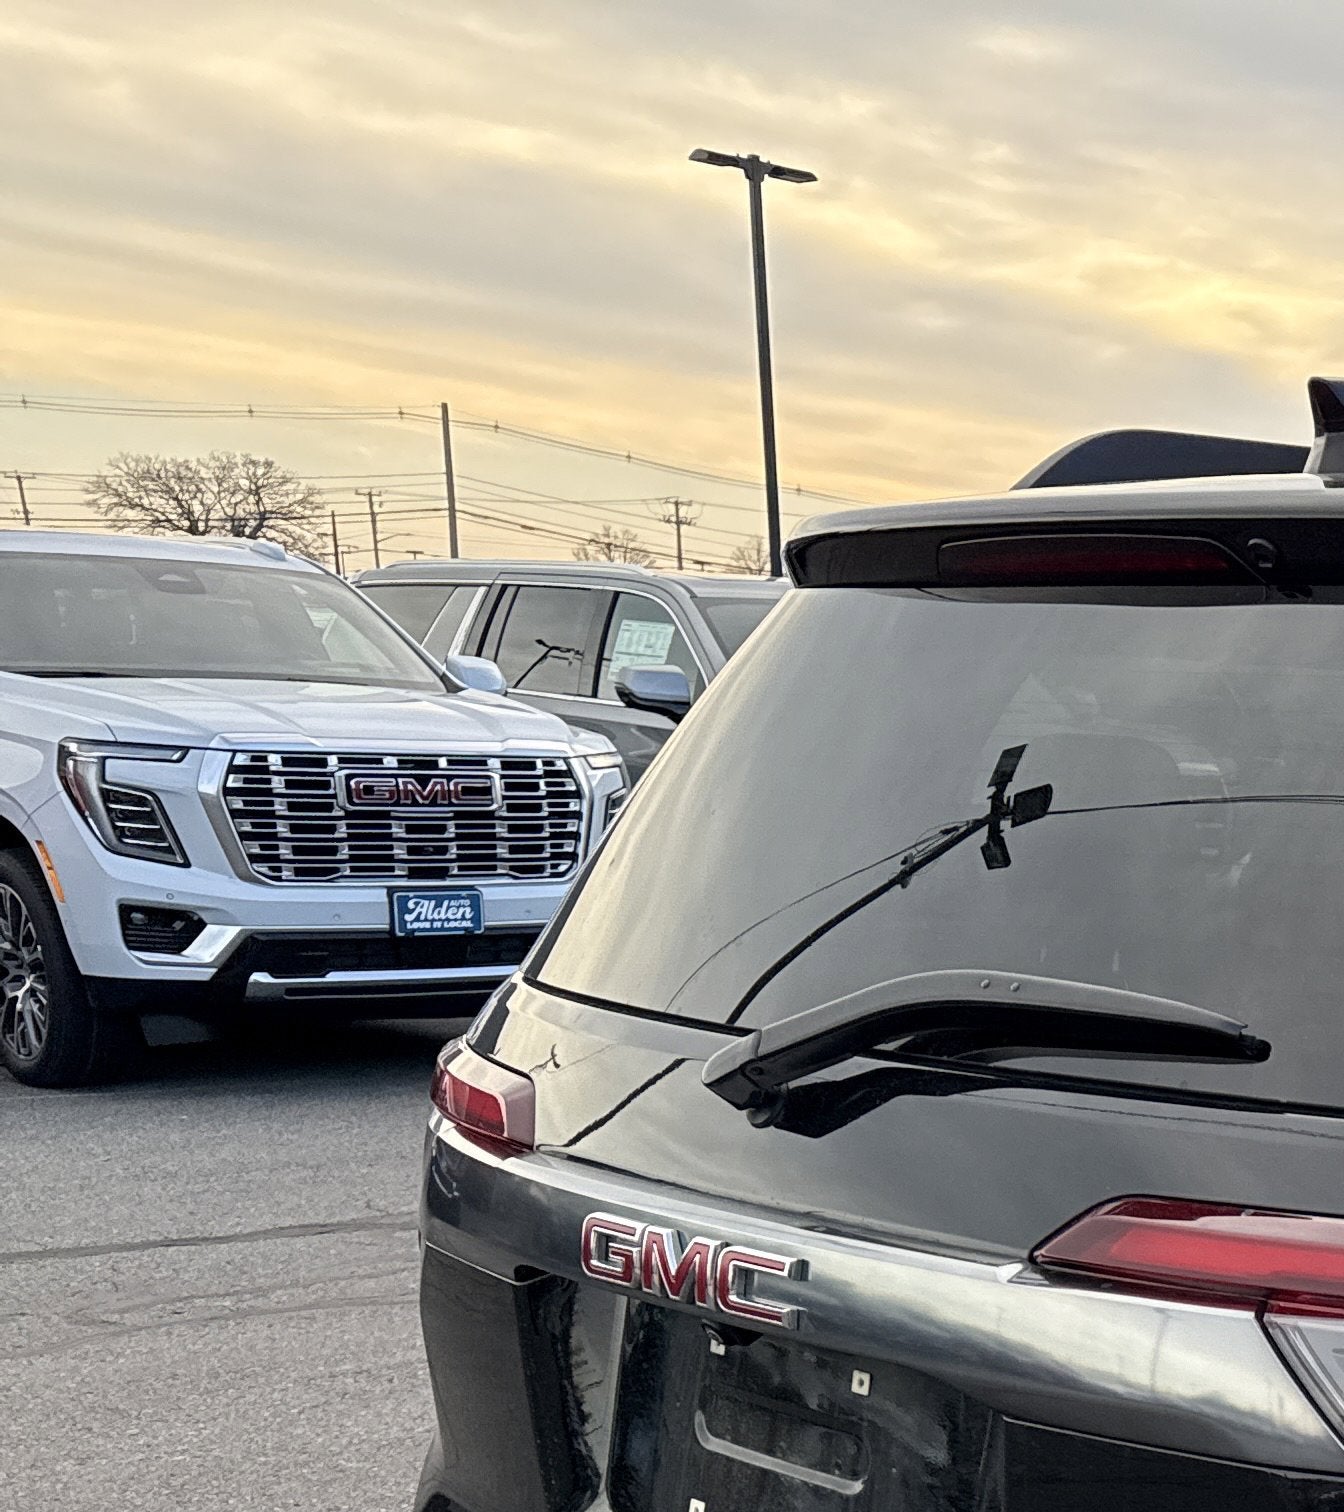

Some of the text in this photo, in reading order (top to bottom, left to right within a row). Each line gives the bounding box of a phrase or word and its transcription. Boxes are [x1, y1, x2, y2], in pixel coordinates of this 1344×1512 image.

[350, 777, 492, 804] GMC
[404, 898, 474, 921] Alden
[406, 921, 431, 929] LOVE
[581, 1211, 810, 1330] GMC
